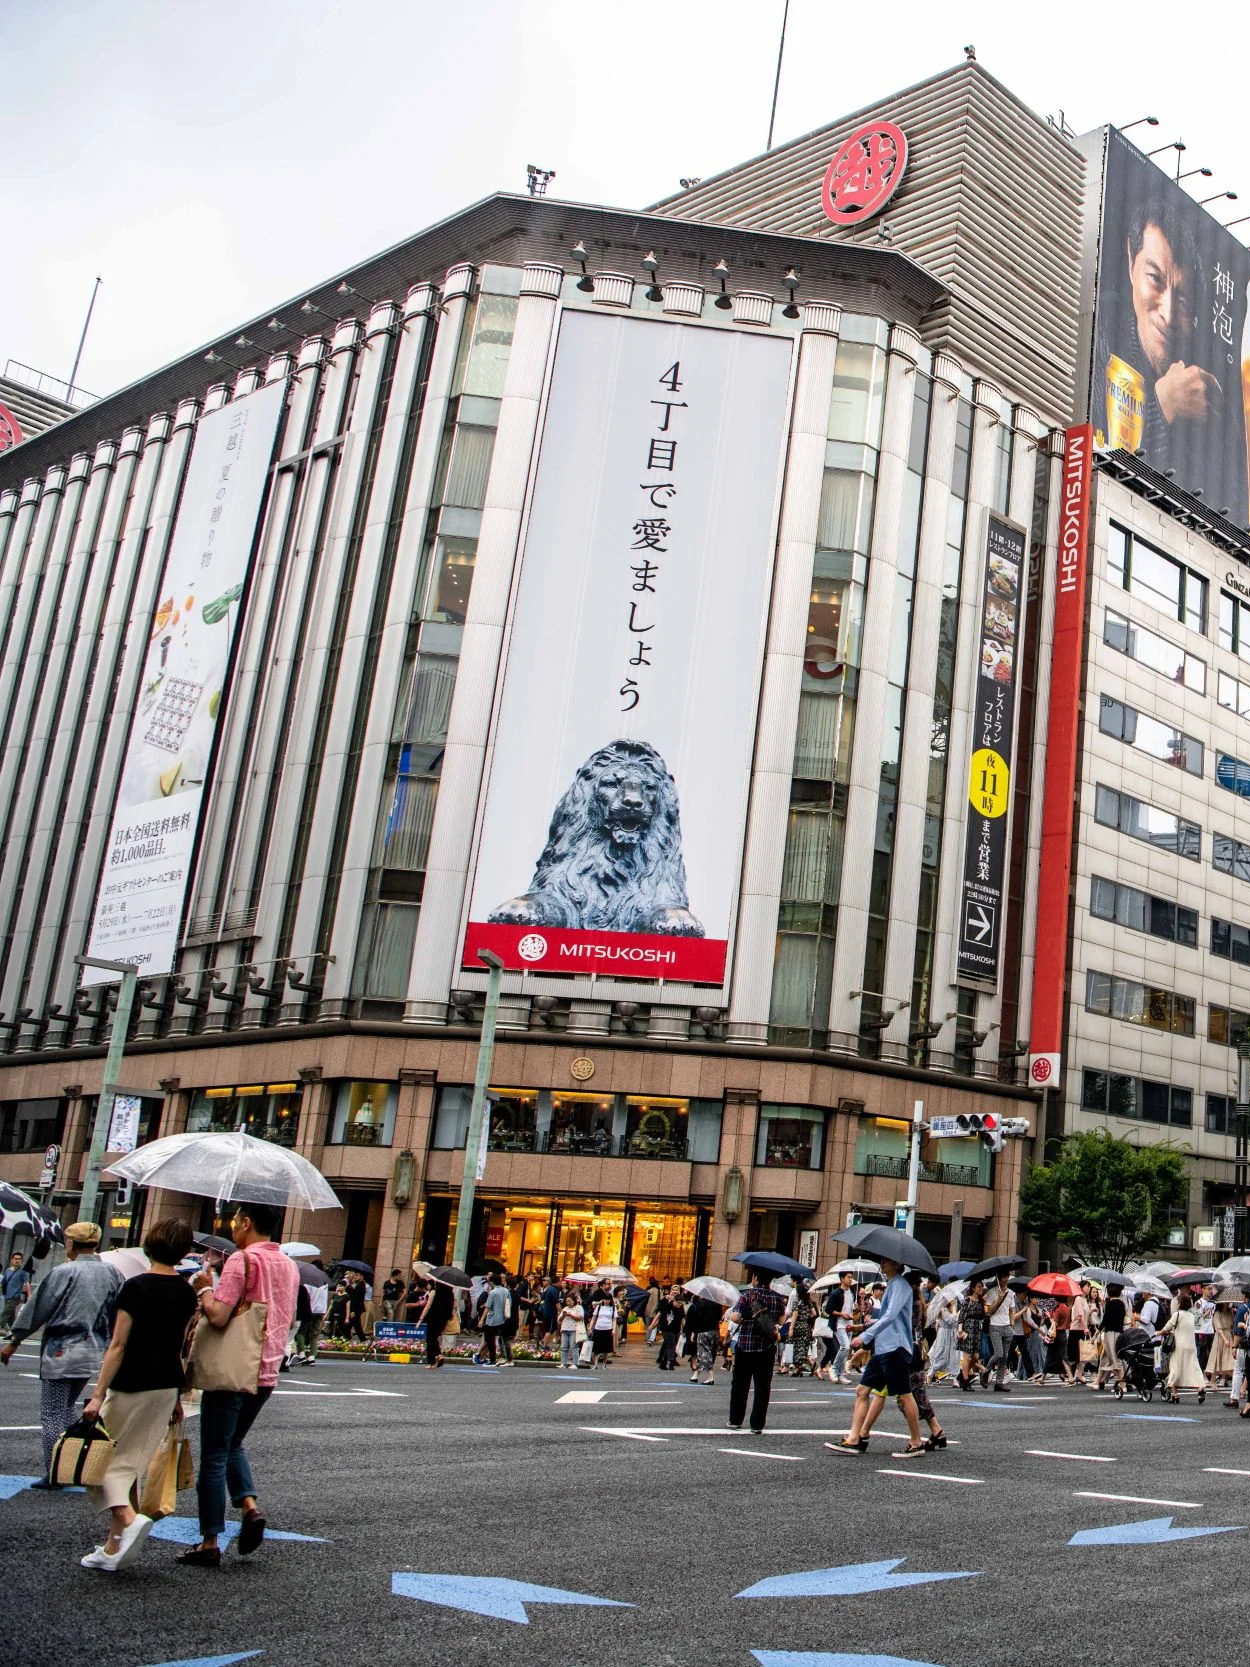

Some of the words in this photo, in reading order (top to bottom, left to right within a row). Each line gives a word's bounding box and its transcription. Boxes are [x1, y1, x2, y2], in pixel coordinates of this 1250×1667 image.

[1212, 261, 1234, 364] 神泡。
[1060, 435, 1084, 593] MITSUKOSHI
[618, 360, 688, 713] 4丁目で愛ましょう
[982, 700, 993, 747] フロアは
[993, 686, 1004, 744] レストラン
[115, 811, 192, 846] 日本全国送料無料
[110, 838, 167, 866] 約1,000品目。
[559, 943, 676, 964] MITSUKOSHI
[958, 951, 996, 966] MITSUKOSHI
[932, 1120, 959, 1131] 銀座四丁
